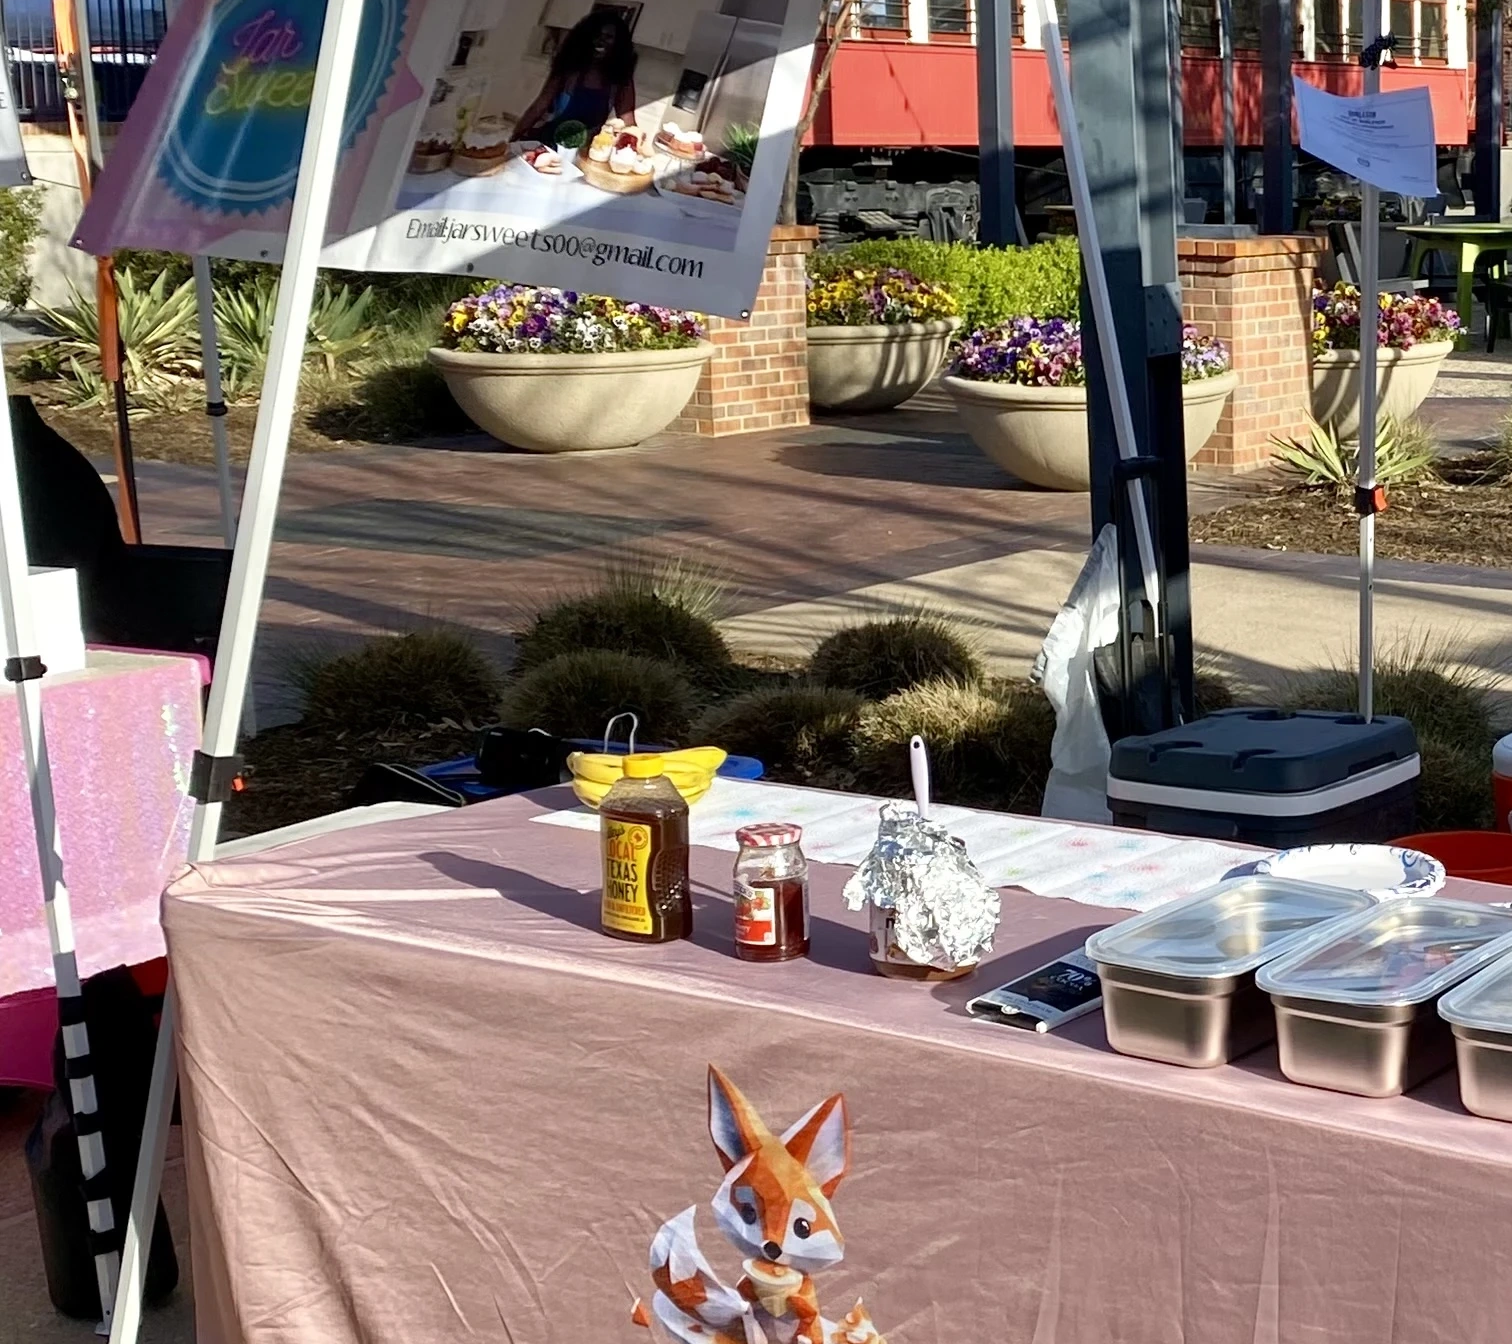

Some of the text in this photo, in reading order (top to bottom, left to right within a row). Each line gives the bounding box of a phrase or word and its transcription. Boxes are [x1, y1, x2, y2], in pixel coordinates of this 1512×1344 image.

[233, 9, 303, 63] Jar
[205, 56, 316, 115] Swee
[606, 857, 638, 883] TEXAS
[606, 879, 639, 903] HONEY
